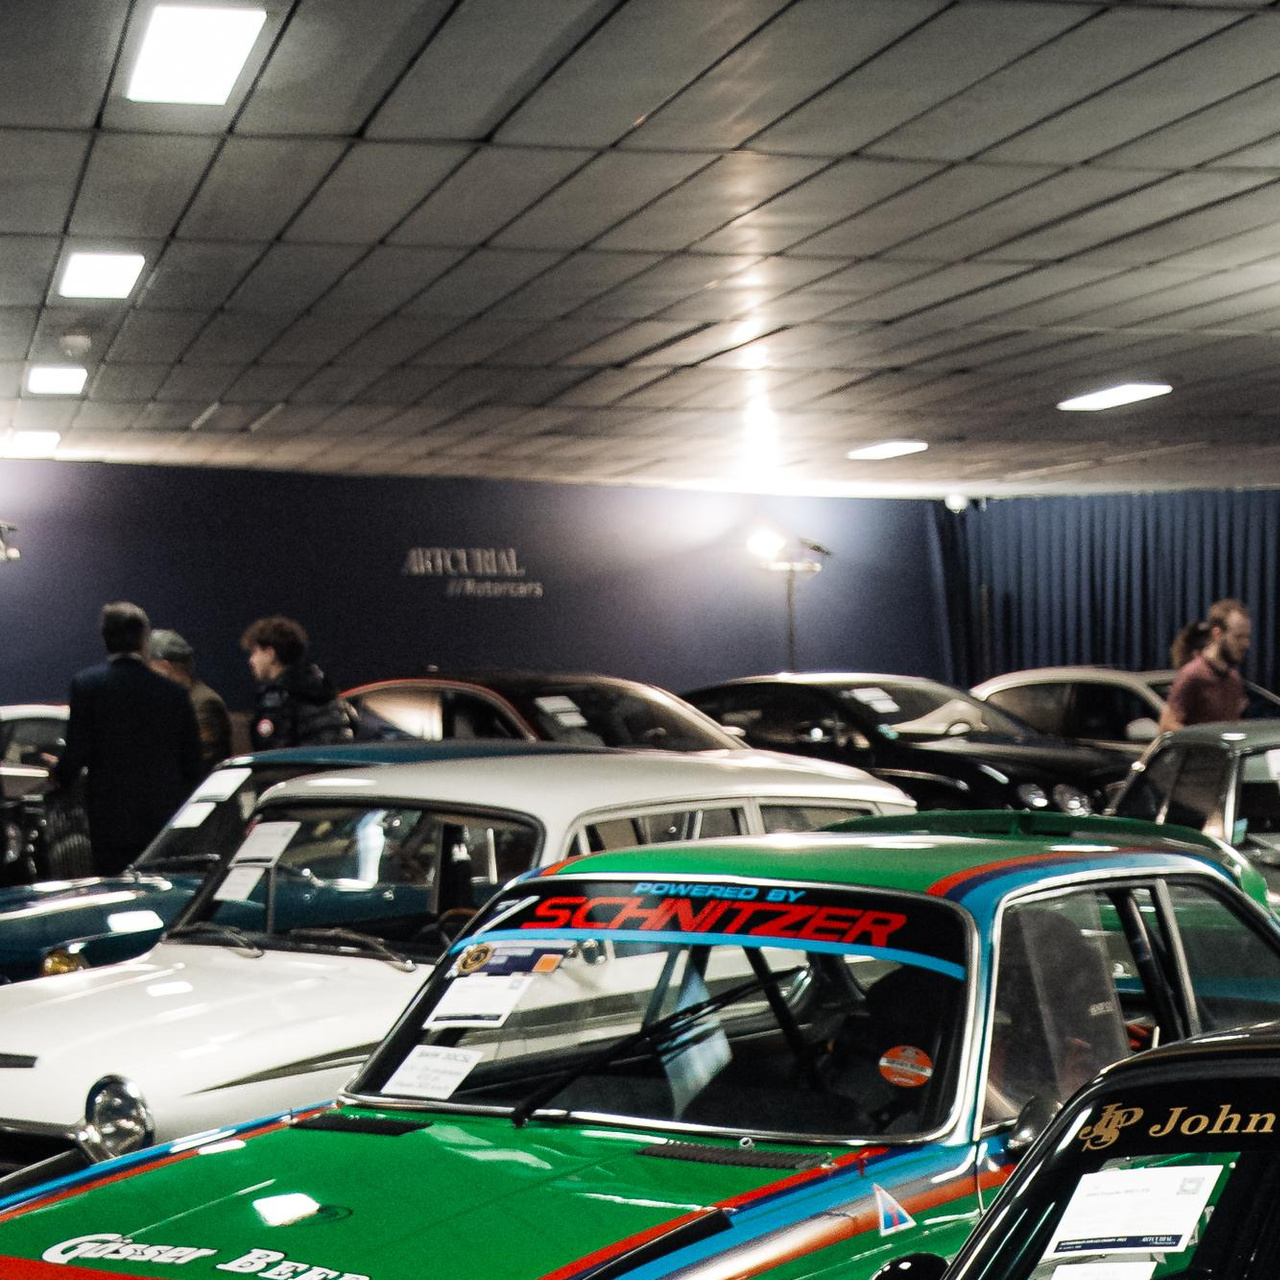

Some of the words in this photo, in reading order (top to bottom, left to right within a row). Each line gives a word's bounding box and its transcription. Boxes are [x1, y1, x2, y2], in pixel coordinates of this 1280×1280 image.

[633, 882, 759, 901] POWERED
[768, 889, 807, 902] BY
[521, 896, 908, 948] SCHNITZER
[1148, 1104, 1276, 1138] John
